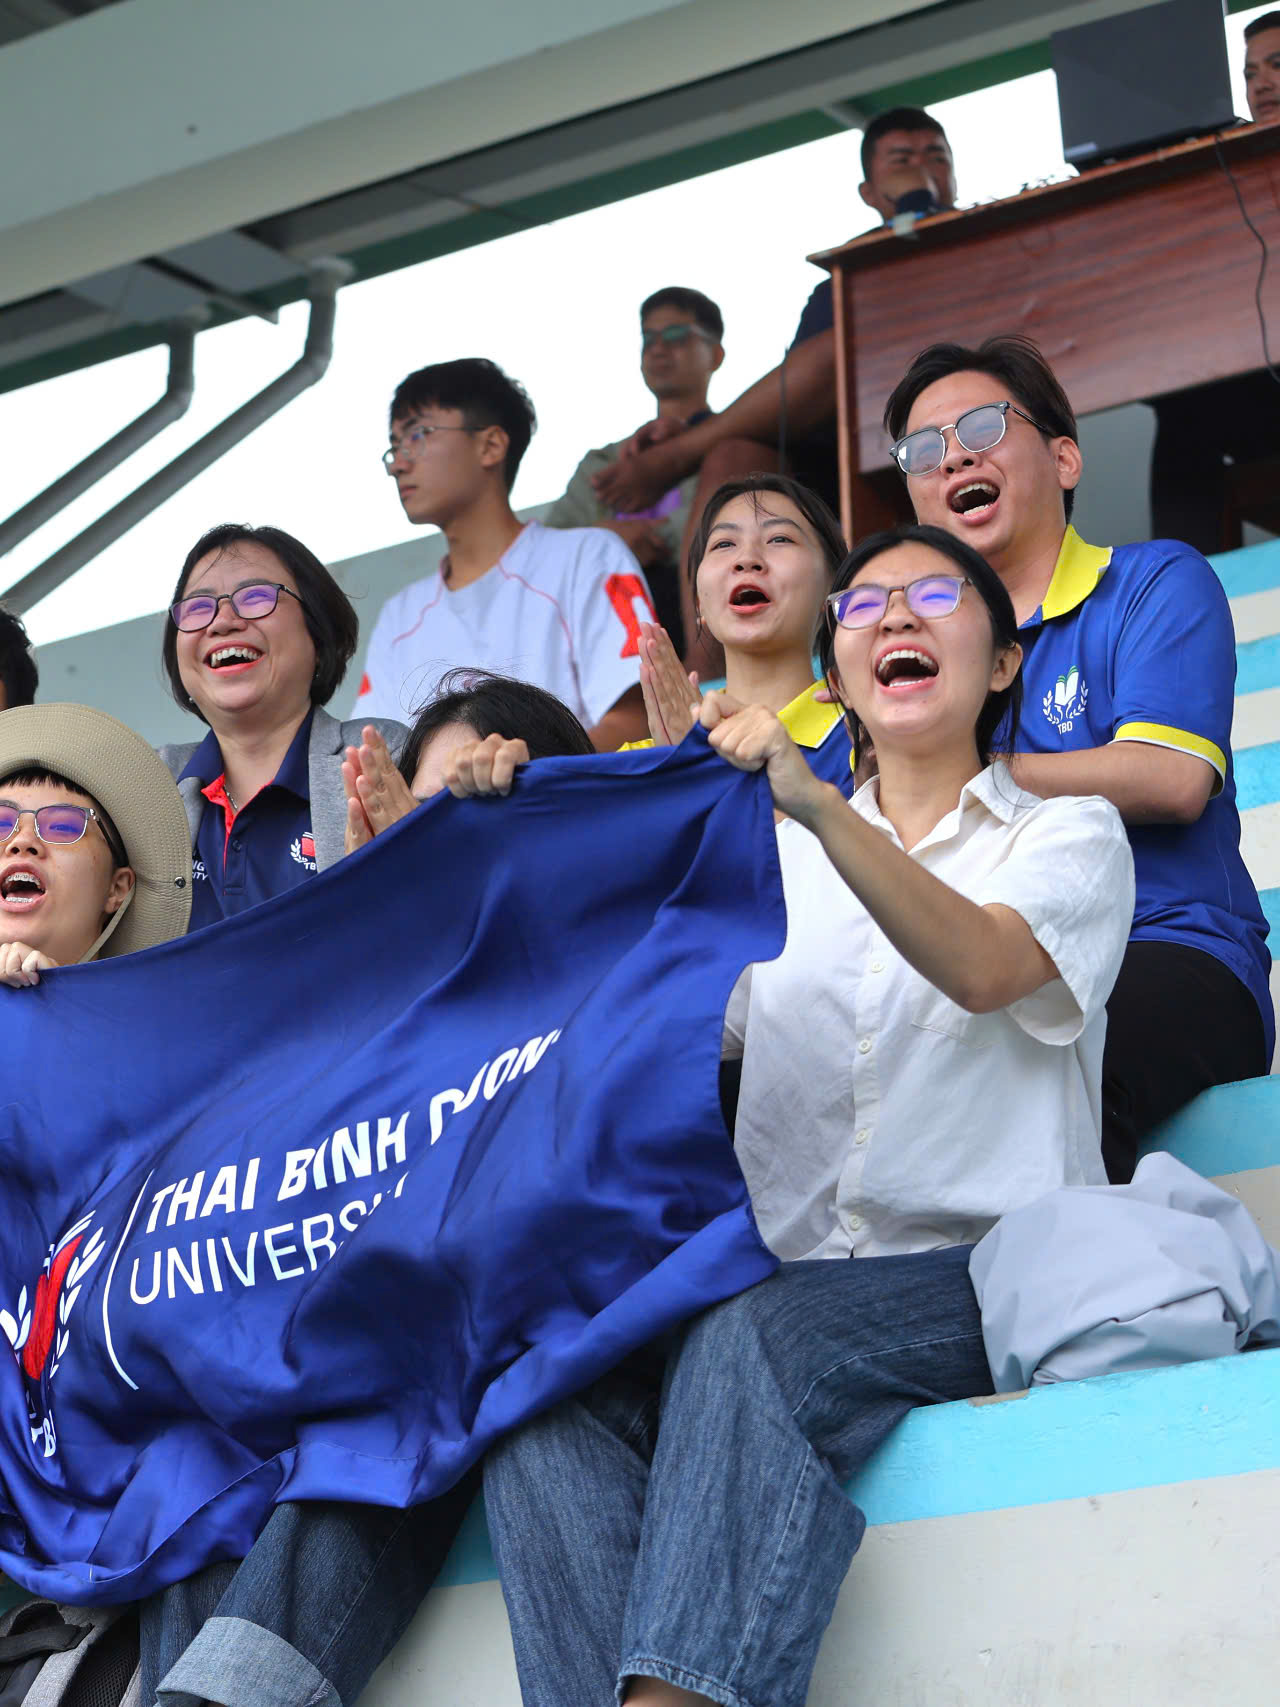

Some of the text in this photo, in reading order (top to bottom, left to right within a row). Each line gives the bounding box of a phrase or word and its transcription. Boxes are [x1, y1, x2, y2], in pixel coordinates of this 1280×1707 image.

[1057, 720, 1073, 735] TBD
[304, 862, 317, 871] TB
[145, 1156, 260, 1233] THAI
[277, 1110, 409, 1202] BINH
[129, 1170, 409, 1305] UNIVERS
[30, 1408, 57, 1458] TB
